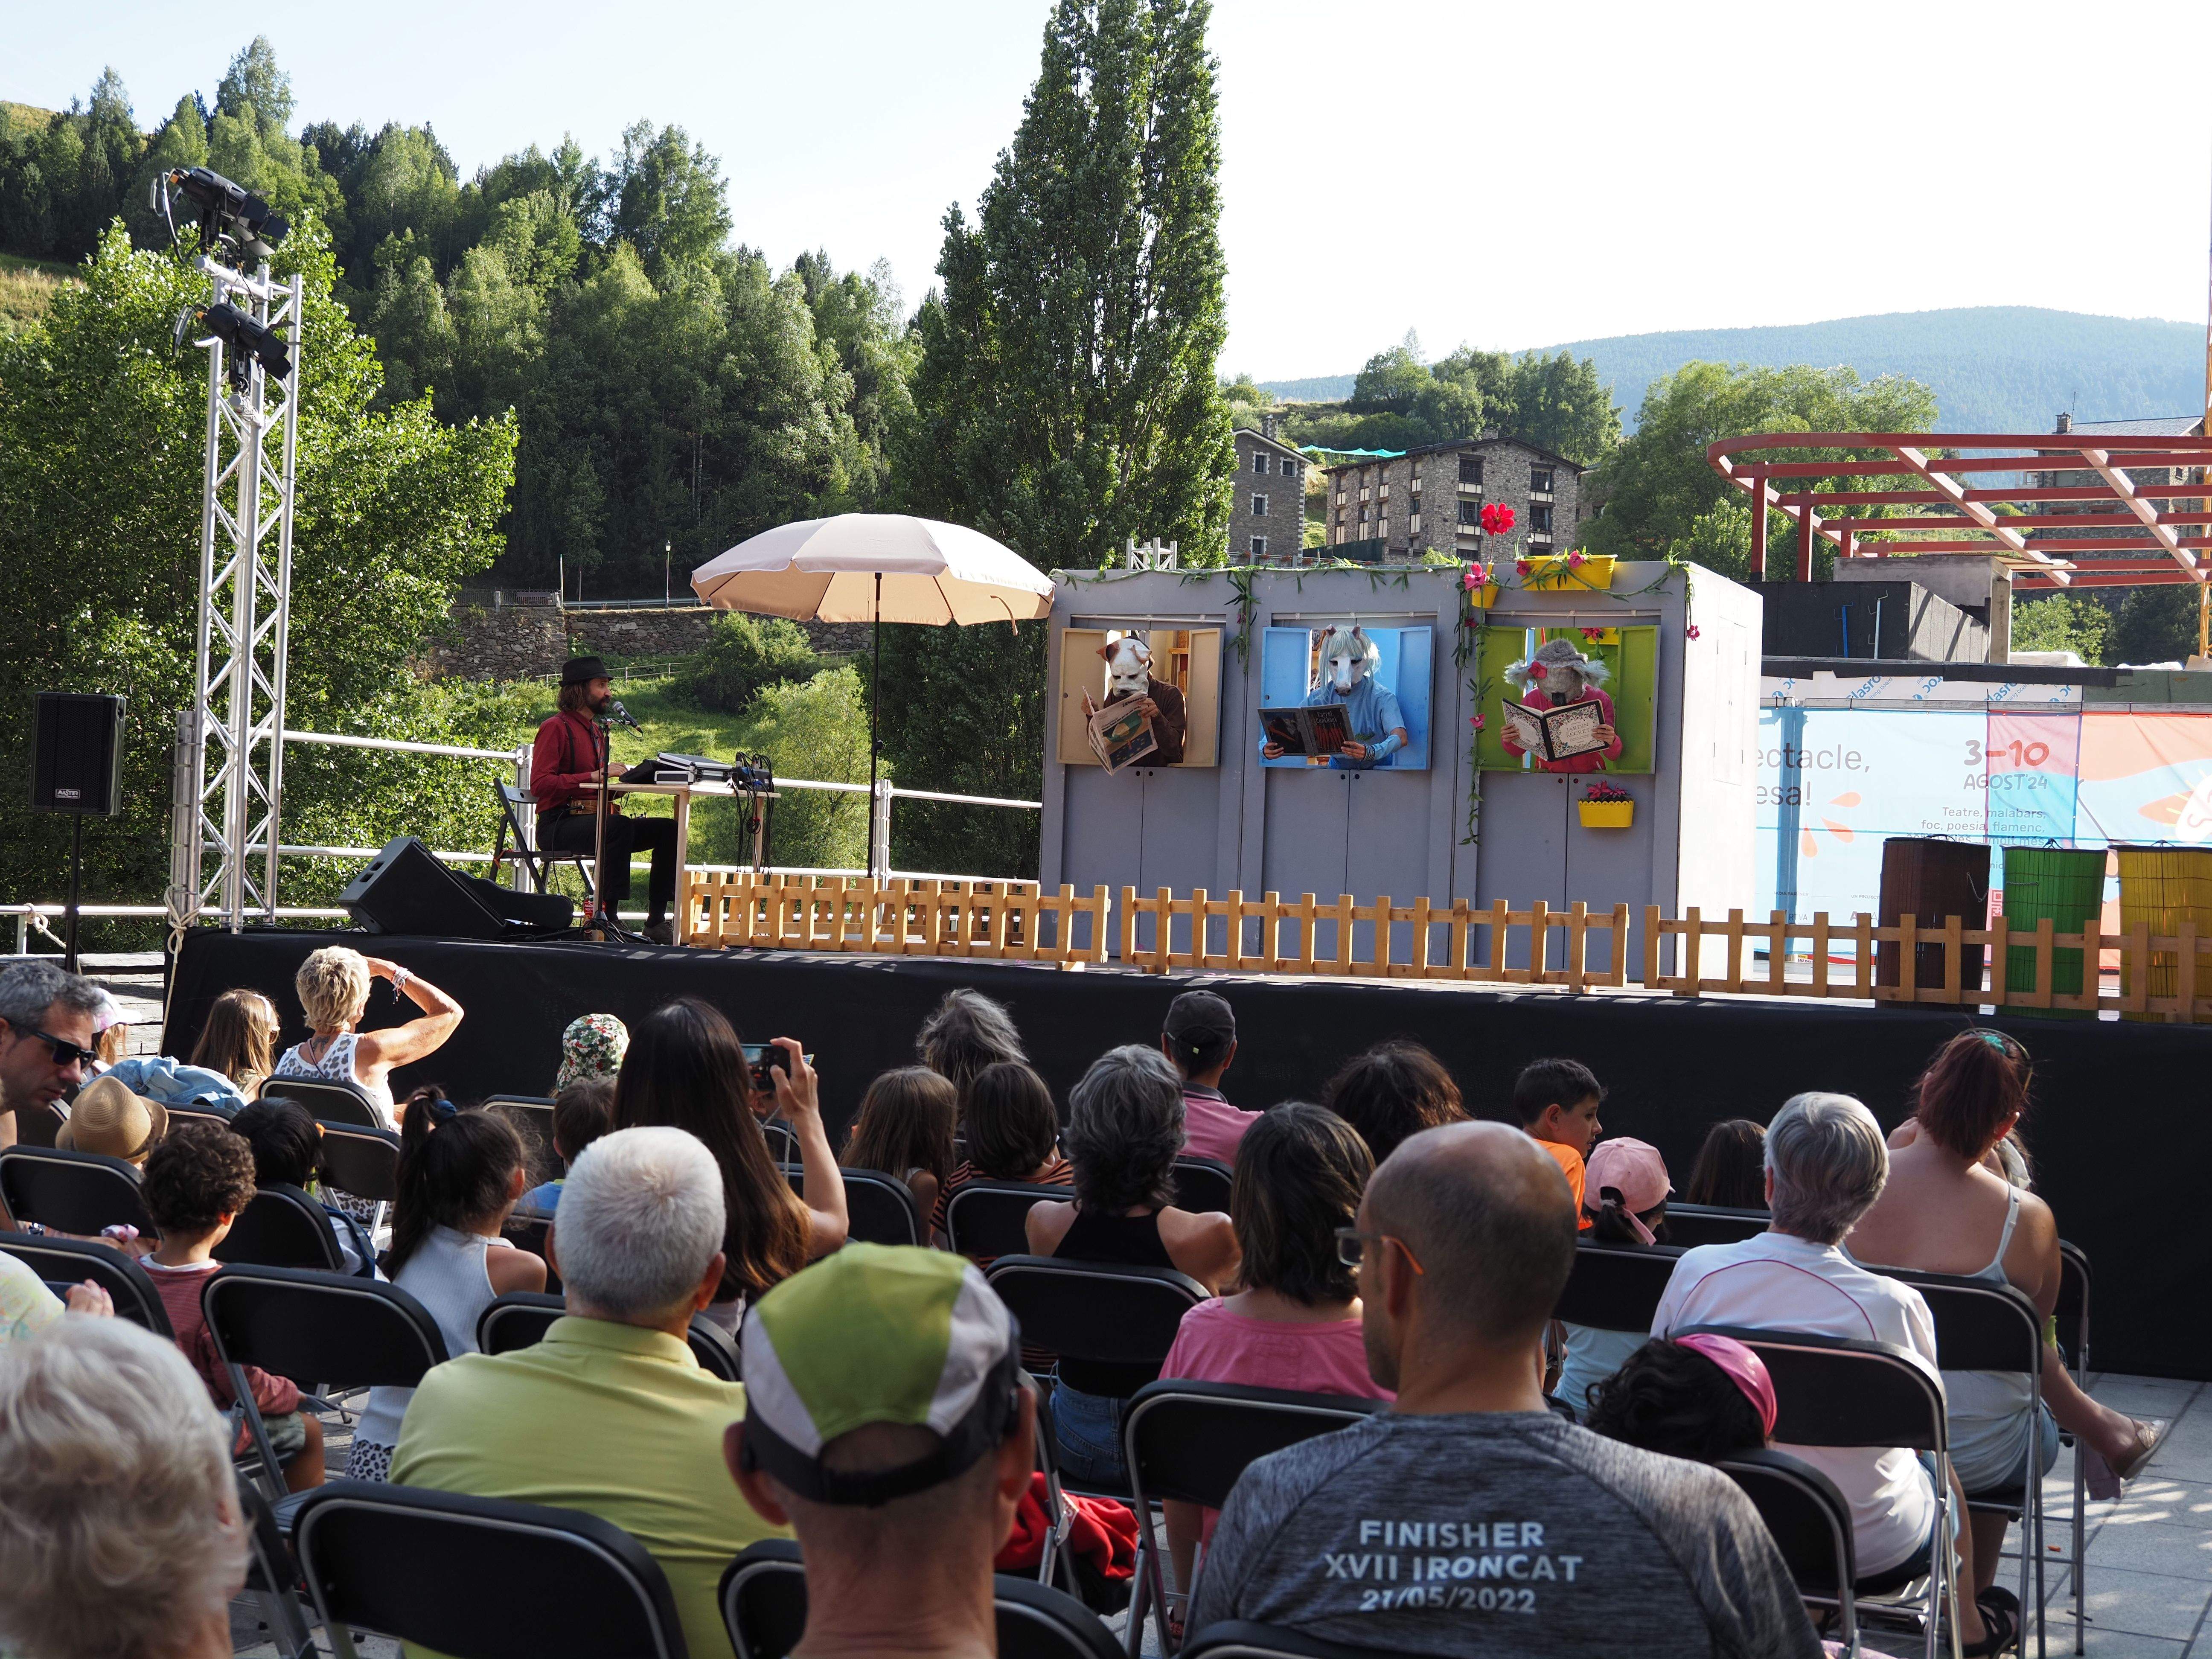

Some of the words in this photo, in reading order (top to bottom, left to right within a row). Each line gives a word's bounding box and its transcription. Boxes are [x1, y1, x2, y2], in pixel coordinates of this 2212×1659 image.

[1846, 676, 1881, 698] lasro
[1984, 683, 2017, 701] lasr
[1566, 723, 1589, 733] JARDIN
[1566, 728, 1590, 737] SECRET
[1963, 773, 2048, 790] AGOST'24
[1942, 807, 1983, 818] Teatre,
[1987, 808, 2046, 819] malabars,
[1921, 820, 1943, 830] foc,
[1993, 821, 2045, 832] flamenc,
[1359, 1520, 1544, 1548] FINISHER
[1324, 1553, 1399, 1581] XVII
[1413, 1554, 1583, 1581] IRONCAT
